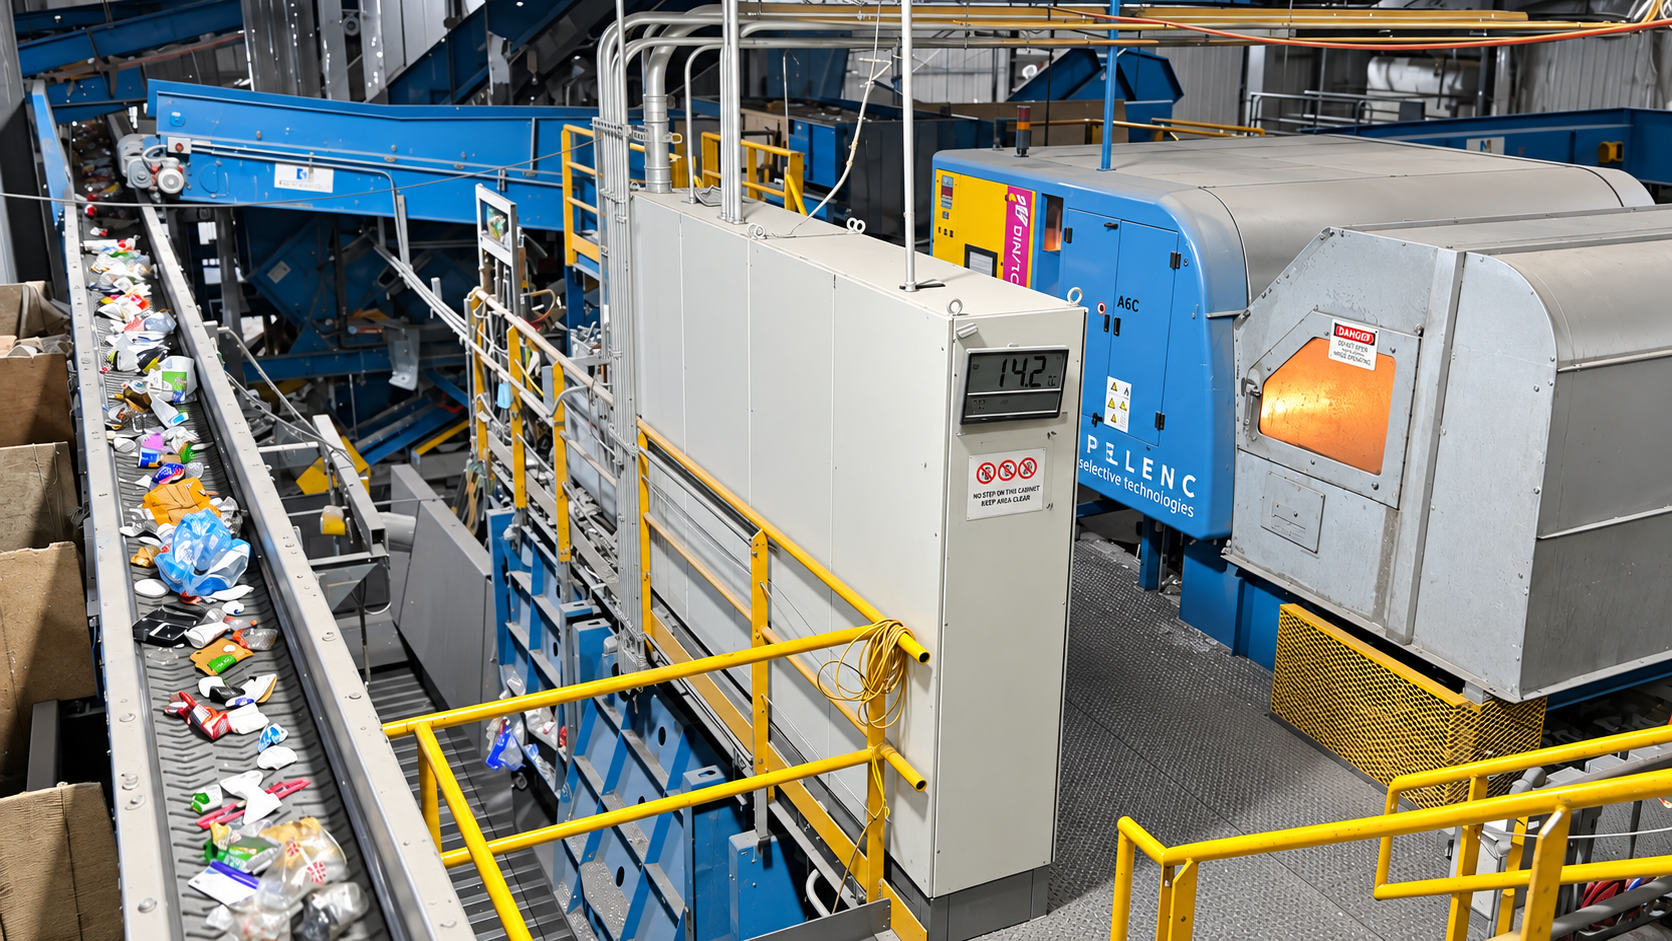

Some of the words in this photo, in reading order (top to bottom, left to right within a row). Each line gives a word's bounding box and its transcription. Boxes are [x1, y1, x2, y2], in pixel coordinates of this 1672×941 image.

[1117, 295, 1140, 312] A6C
[999, 355, 1047, 388] 14.2
[1079, 458, 1122, 486] selective
[1087, 434, 1197, 498] PELENC
